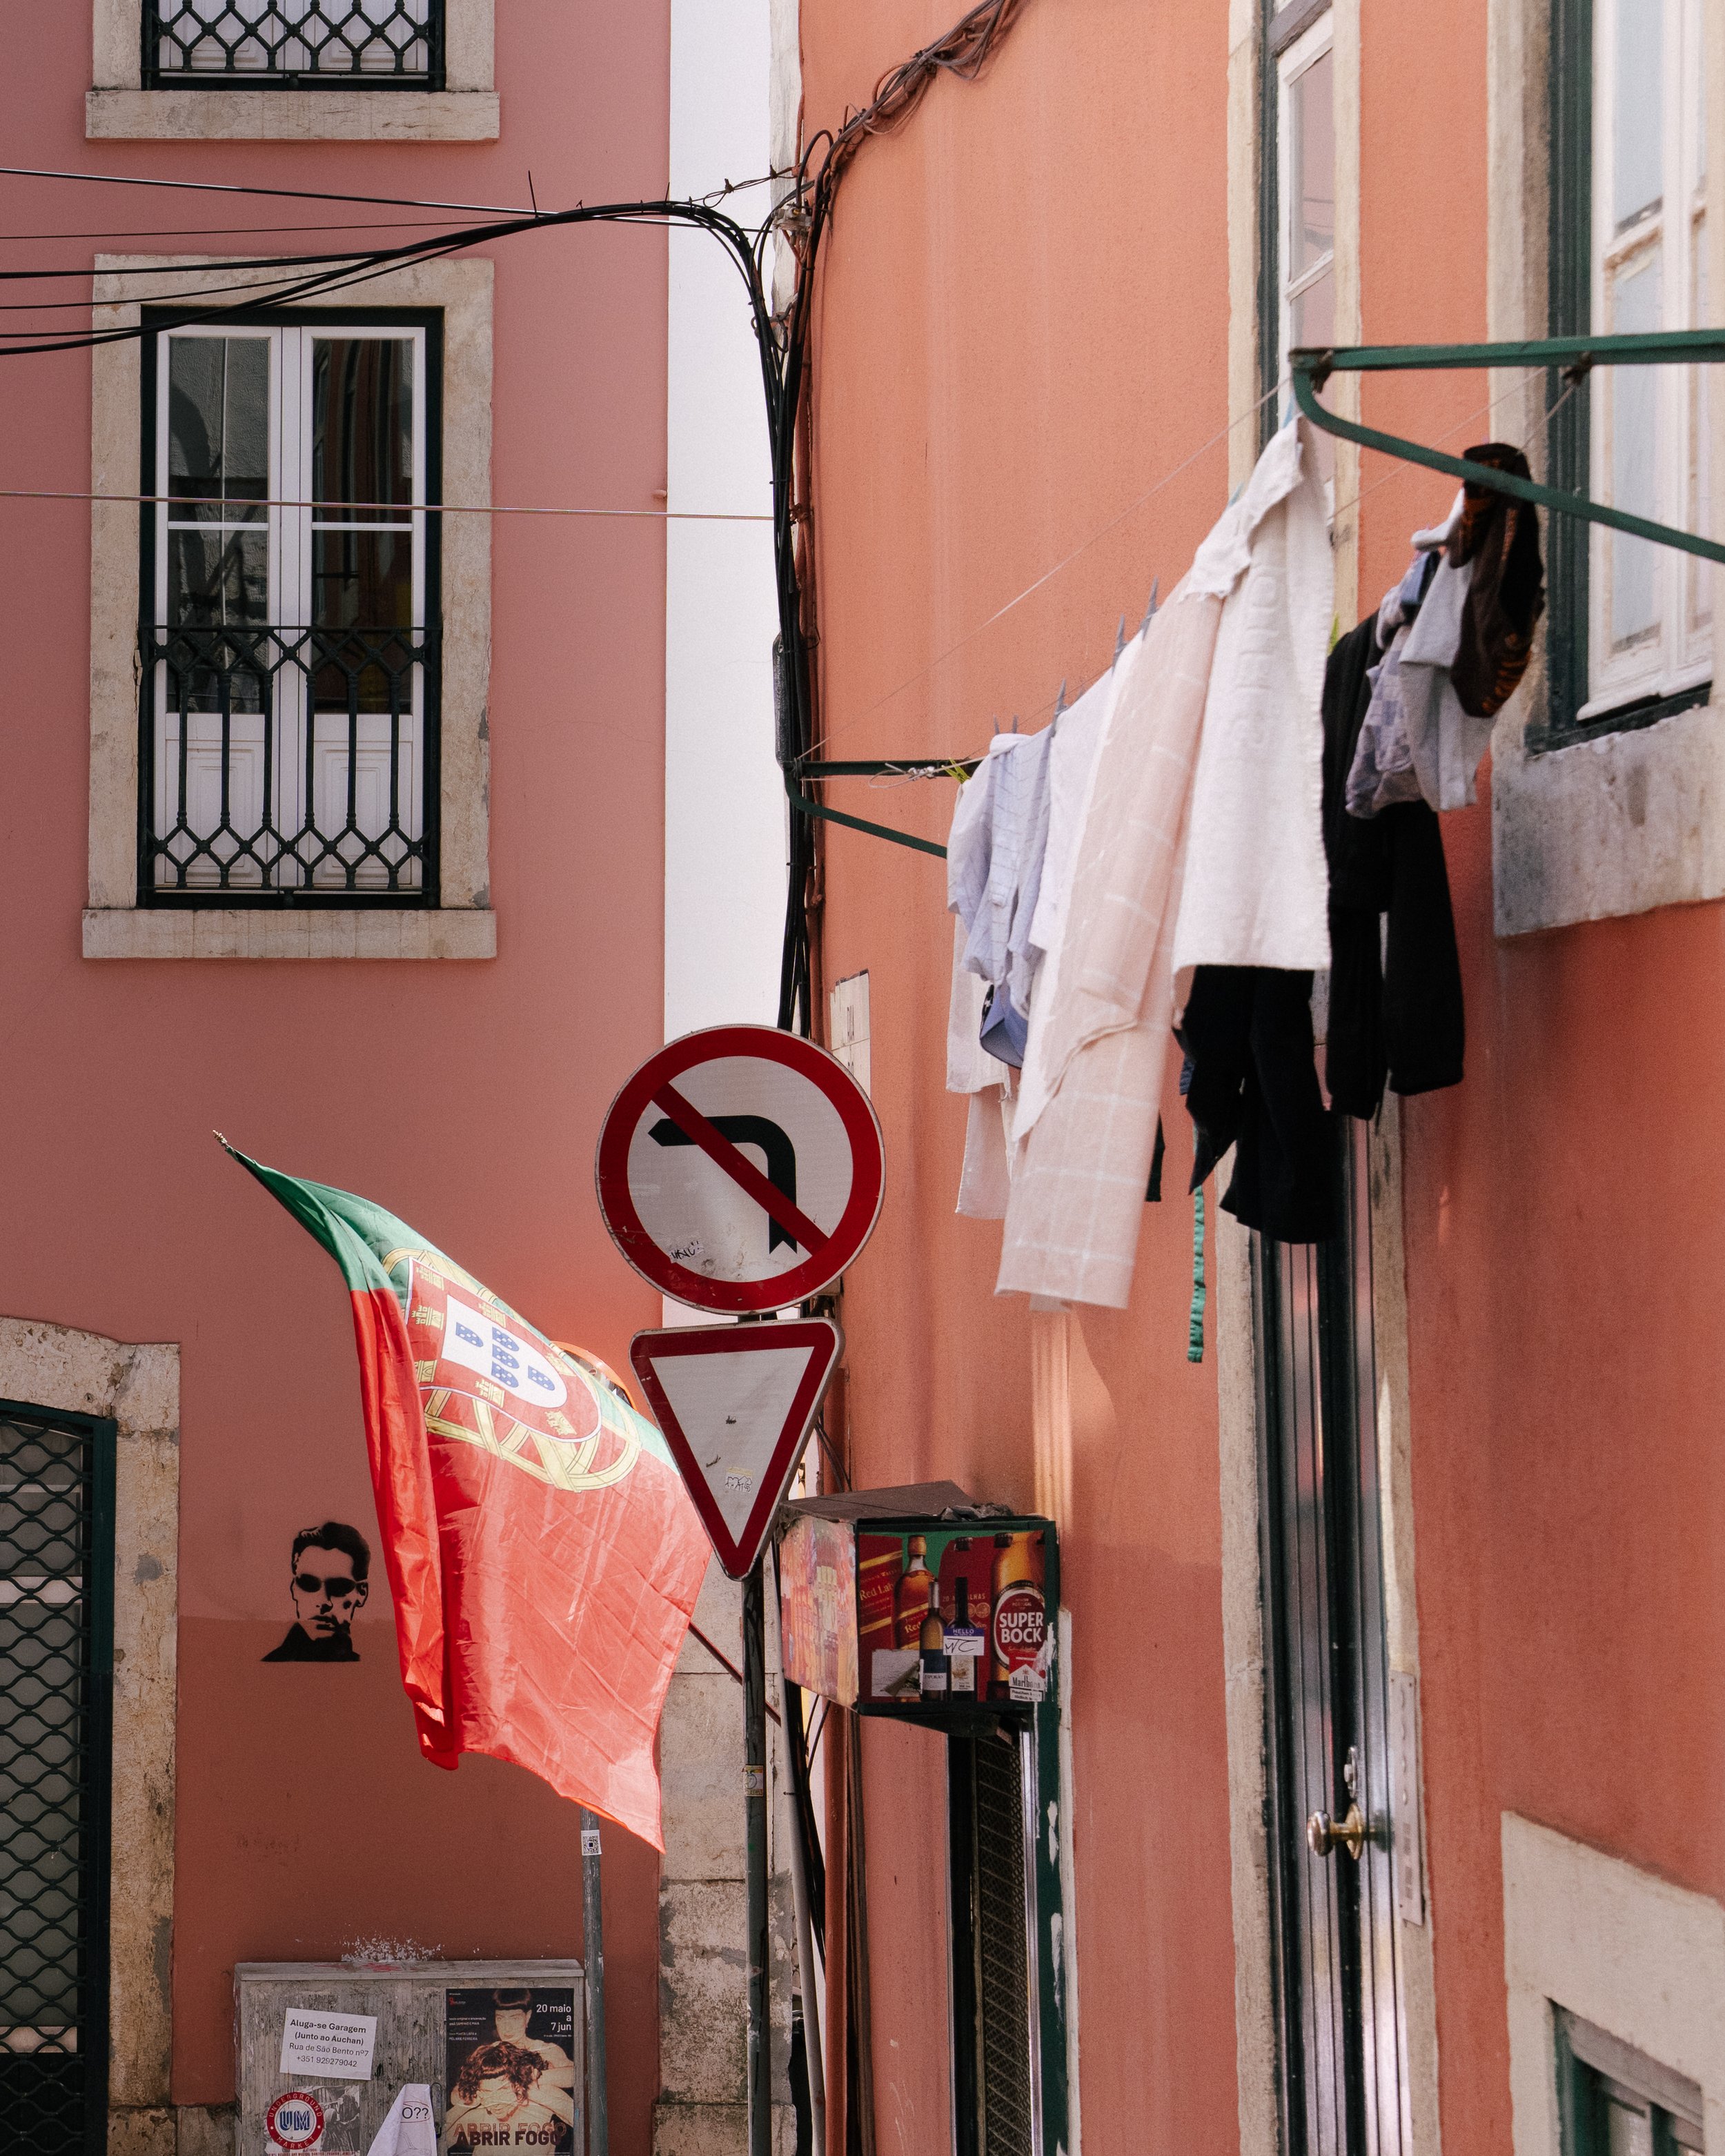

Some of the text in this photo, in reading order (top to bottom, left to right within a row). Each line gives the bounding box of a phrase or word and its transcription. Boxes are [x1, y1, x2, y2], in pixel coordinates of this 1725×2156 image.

[860, 1585, 877, 1601] Red
[999, 1612, 1043, 1628] SUPER
[1001, 1628, 1042, 1643] BOCK
[536, 2004, 571, 2012] 20 maio
[290, 2019, 366, 2033] Aluga-se Garagem
[551, 2022, 571, 2033] 7 jun
[295, 2031, 319, 2040] (Junto
[331, 2035, 364, 2046] Auchan)
[289, 2042, 304, 2050] Rua
[332, 2046, 354, 2055] Bento
[316, 2057, 357, 2067] 929279042
[268, 2093, 323, 2118] UNDERGROUND
[402, 2107, 429, 2119] O??
[279, 2110, 310, 2131] UM
[276, 2137, 315, 2149] MARKET
[456, 2130, 562, 2146] ABRIR FOGO
